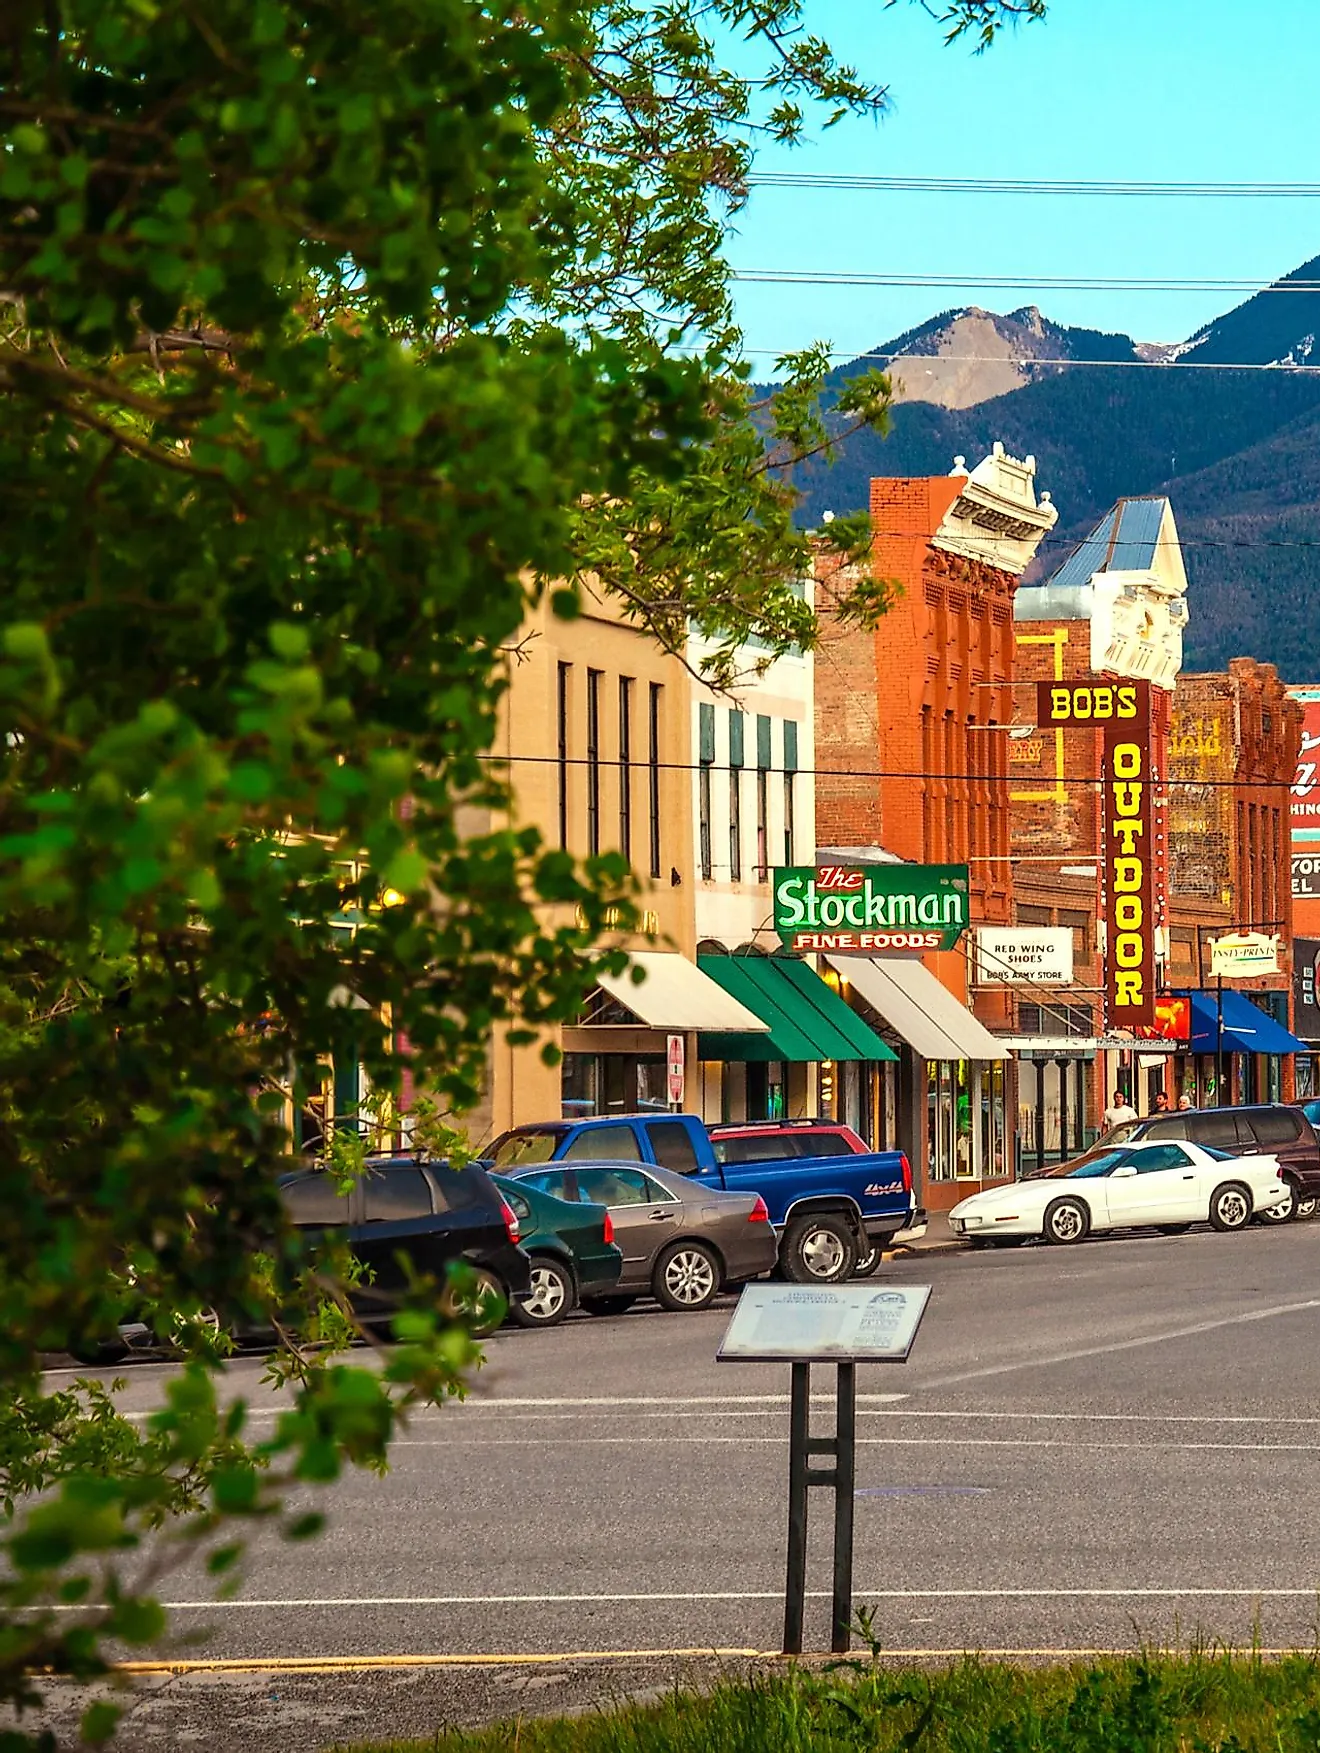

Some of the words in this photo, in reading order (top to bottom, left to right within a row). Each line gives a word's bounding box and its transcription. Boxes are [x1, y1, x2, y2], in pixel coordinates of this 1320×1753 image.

[1050, 685, 1137, 719] BOB'S
[816, 866, 864, 888] The
[1112, 743, 1143, 1006] OUTDOOR
[776, 877, 964, 926] Stockman
[793, 933, 857, 949] FINE
[860, 932, 942, 948] FOODS
[994, 944, 1016, 953] RED
[1020, 944, 1055, 953] WING
[1008, 954, 1042, 963] SHOES
[986, 970, 1009, 980] BOB'S
[1012, 970, 1035, 980] ARMY
[1037, 970, 1063, 980] STORE
